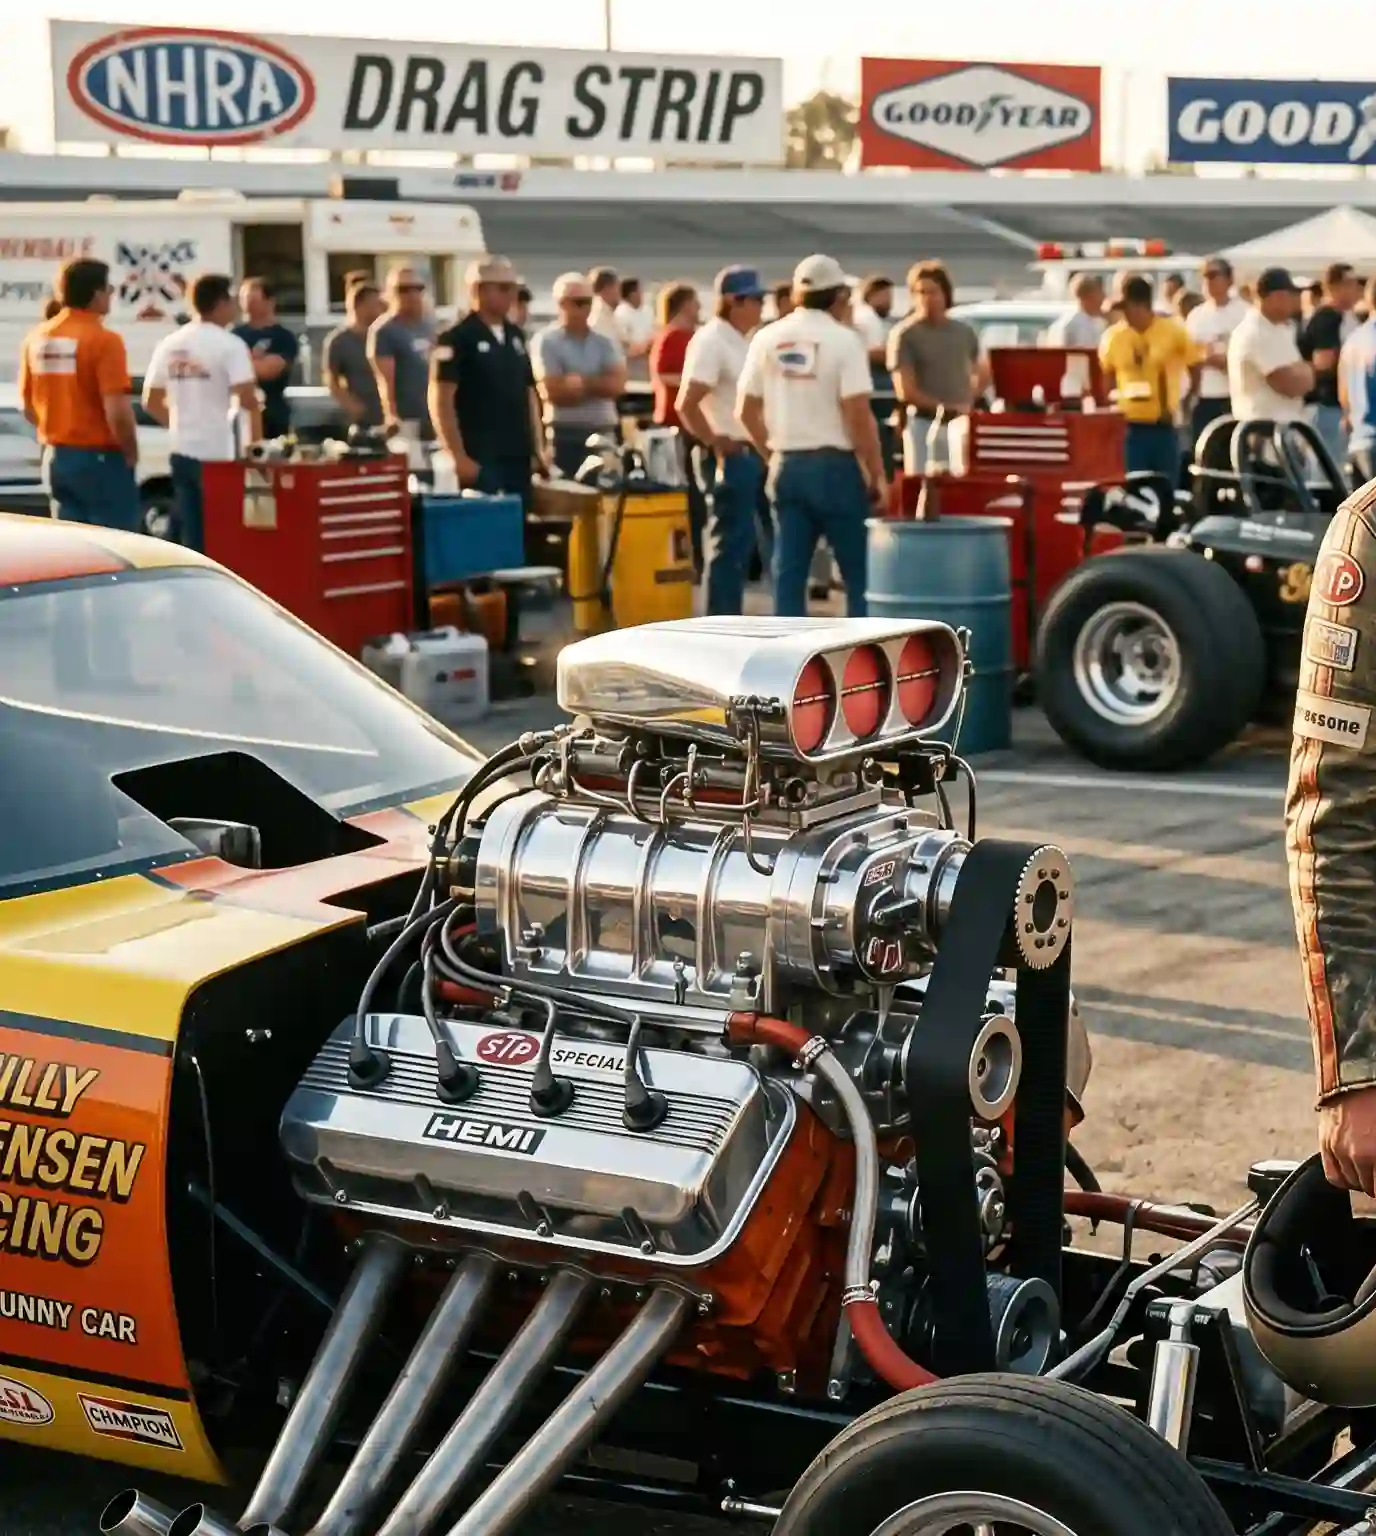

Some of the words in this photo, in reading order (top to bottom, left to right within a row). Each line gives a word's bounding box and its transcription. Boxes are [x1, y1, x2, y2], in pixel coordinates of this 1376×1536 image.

[106, 46, 286, 128] NHRA
[342, 53, 546, 138] DRAG
[565, 56, 766, 145] STRIP
[481, 1033, 533, 1059] STP
[552, 1049, 625, 1072] SPECIAL
[0, 1054, 100, 1116] ILLY
[425, 1115, 536, 1151] HEMI
[81, 1307, 137, 1344] CAR
